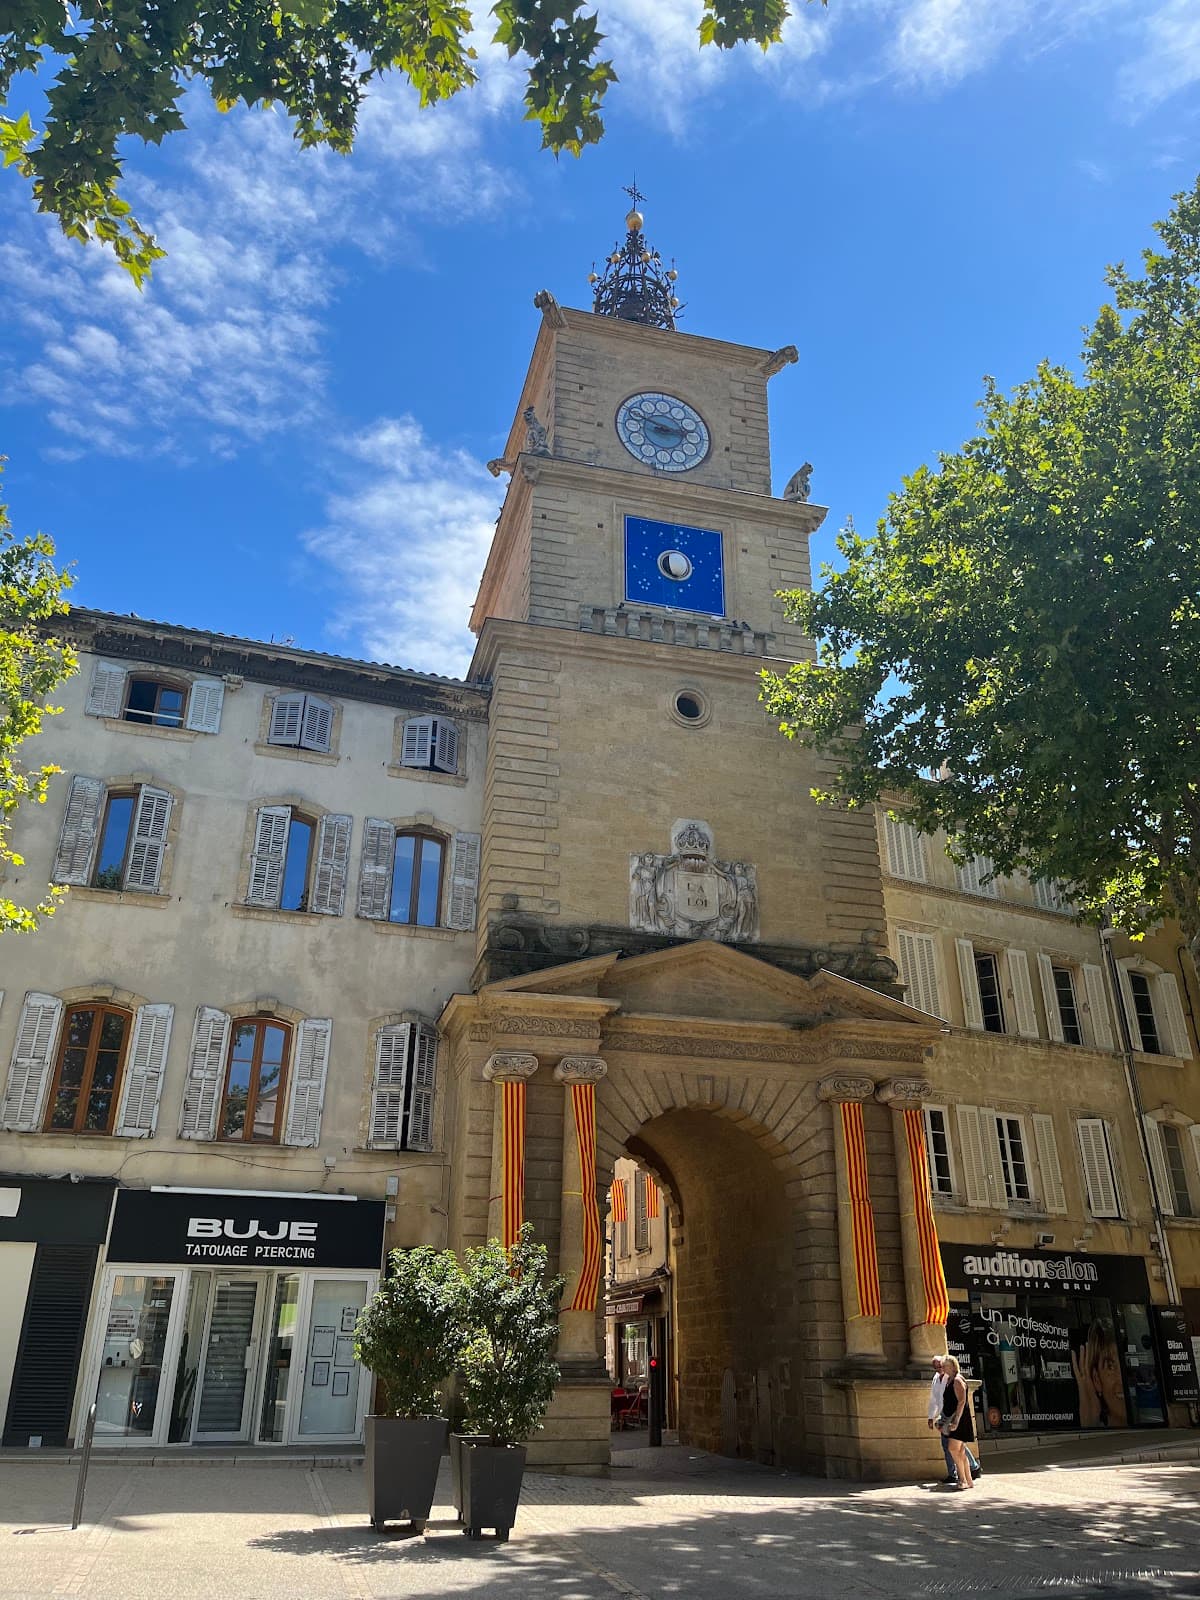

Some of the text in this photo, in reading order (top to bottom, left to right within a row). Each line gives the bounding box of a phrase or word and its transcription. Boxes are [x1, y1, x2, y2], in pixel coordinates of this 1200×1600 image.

[187, 1217, 319, 1241] BUJE
[185, 1243, 316, 1259] TATOUAGE PIERCING
[973, 1278, 1092, 1291] PATRICIA BRU
[1007, 1313, 1069, 1338] professionnel
[986, 1326, 1000, 1346] à
[1004, 1333, 1037, 1348] votre
[1167, 1340, 1184, 1350] Bilan
